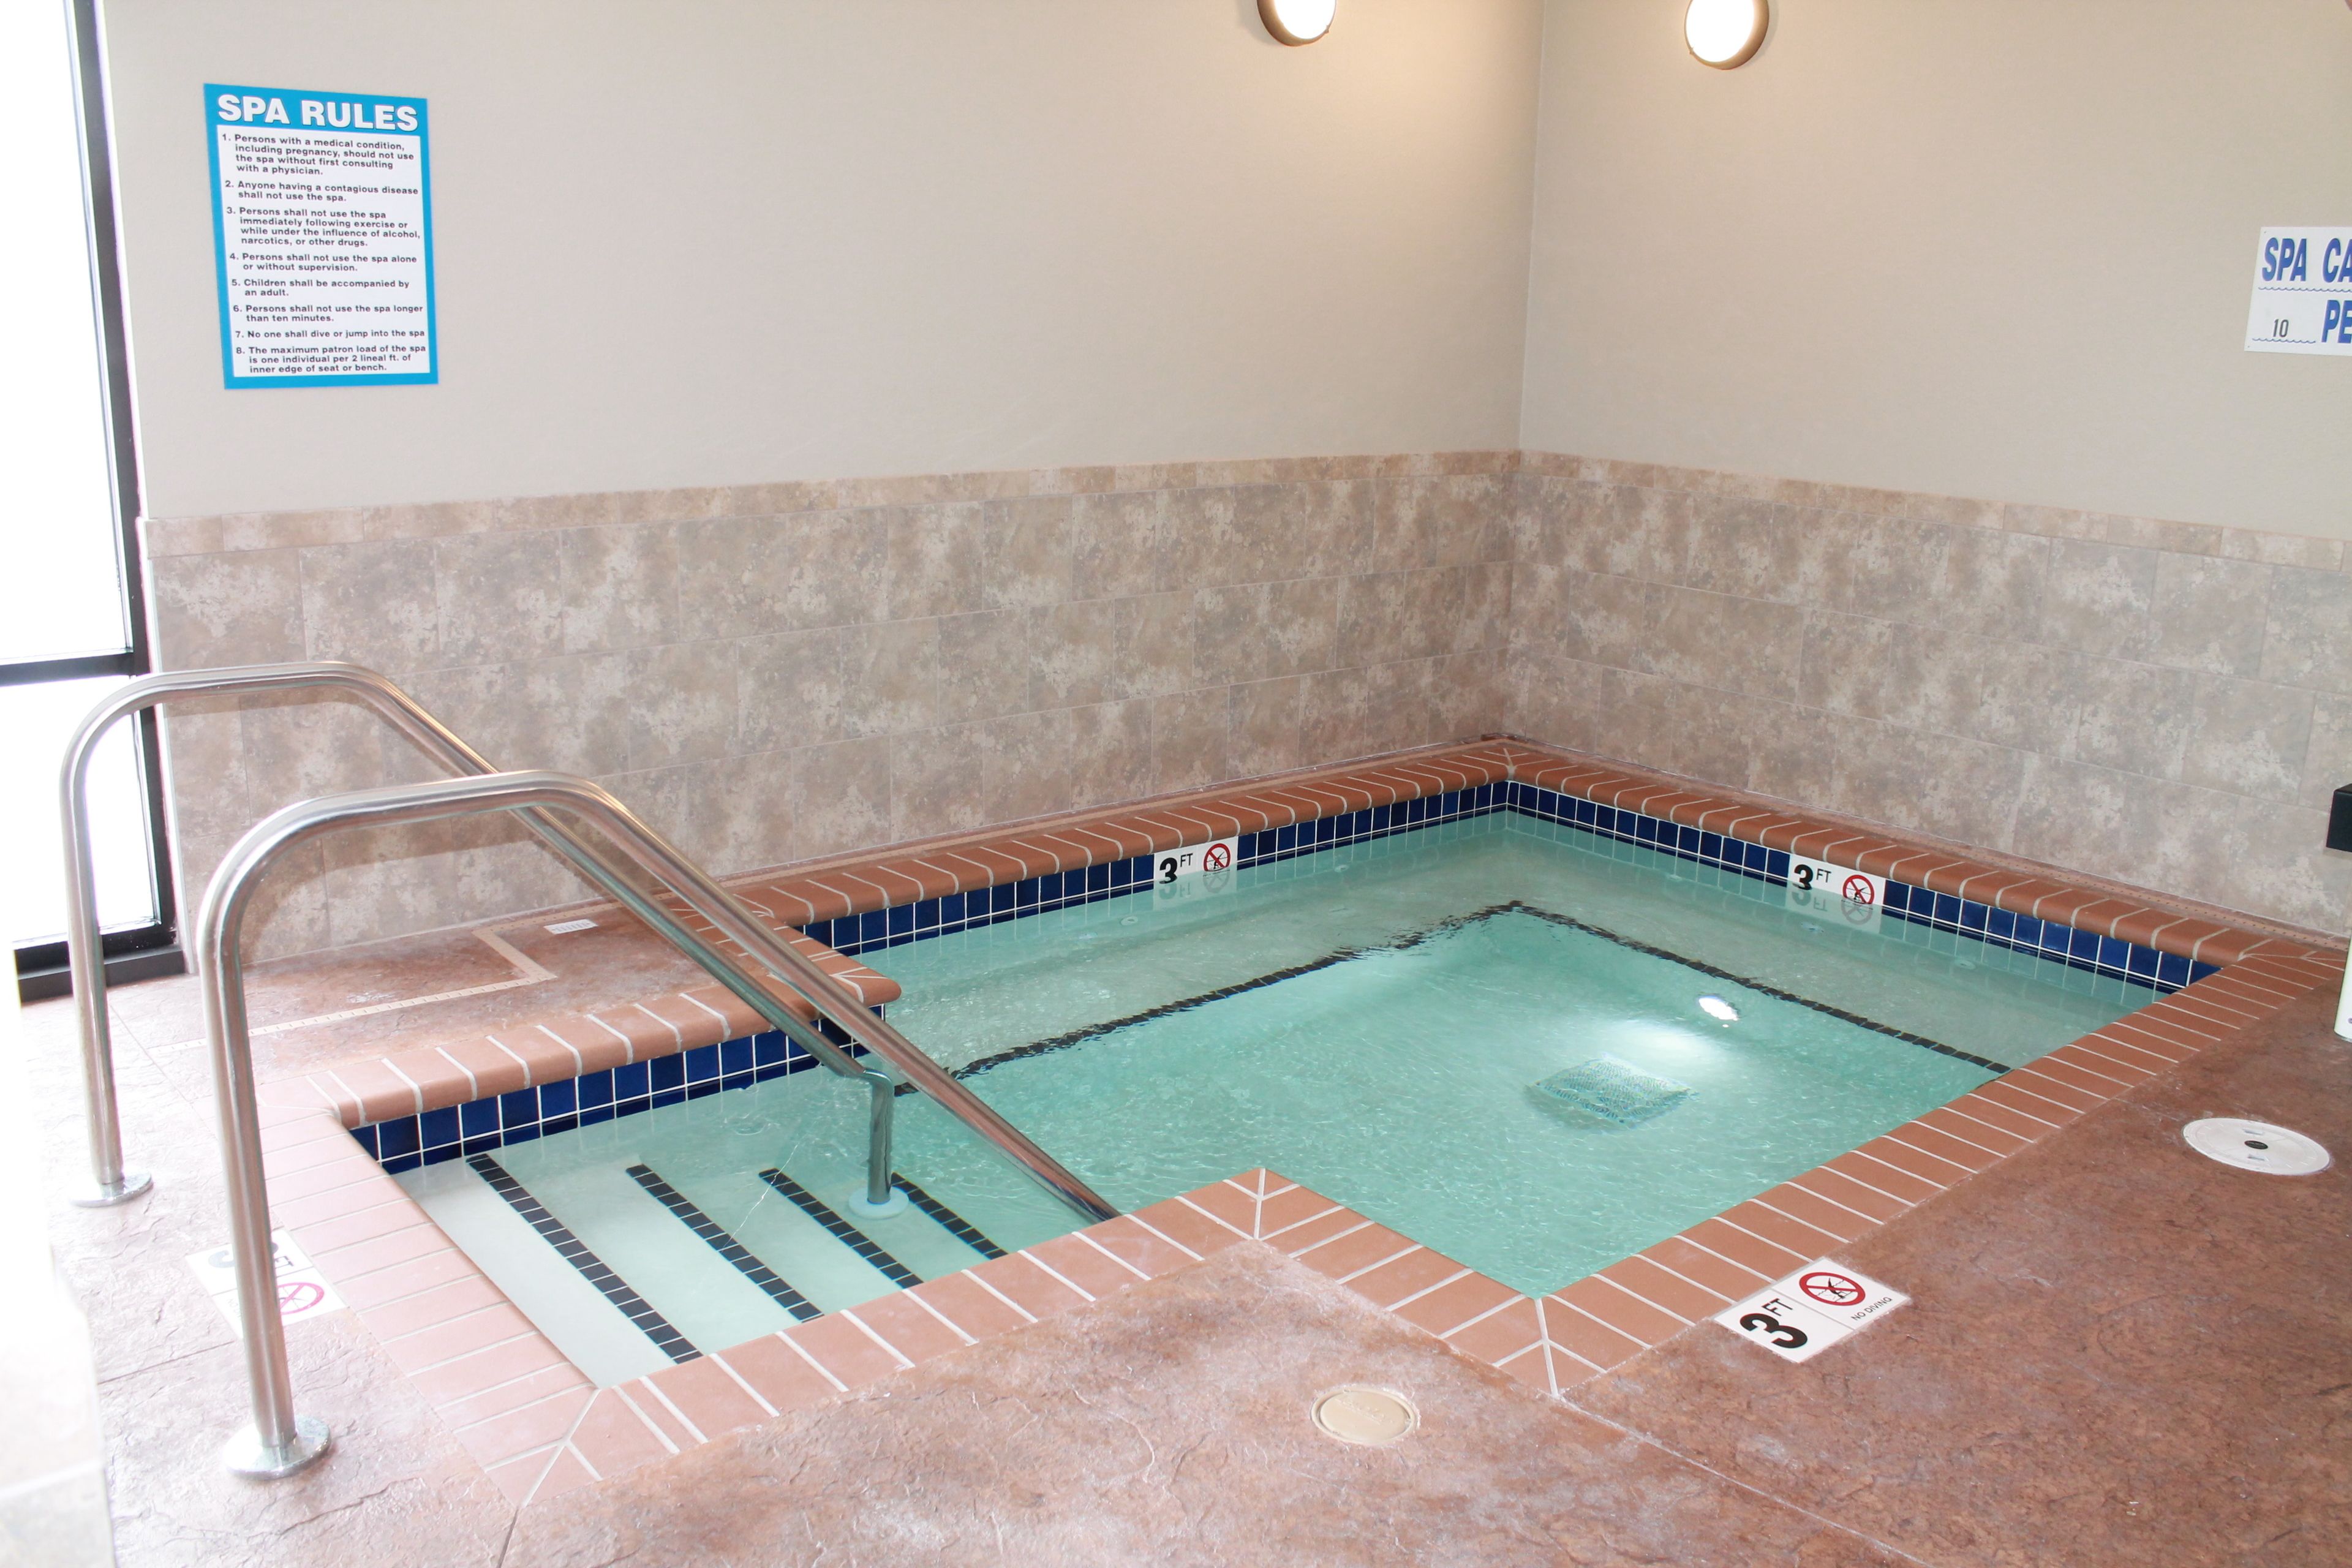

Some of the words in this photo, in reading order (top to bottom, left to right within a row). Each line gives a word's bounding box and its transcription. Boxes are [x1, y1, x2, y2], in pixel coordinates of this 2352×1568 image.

[217, 94, 290, 124] SPA
[301, 99, 418, 132] RULES
[235, 134, 276, 143] Persons
[279, 137, 301, 145] with
[314, 139, 353, 148] medical
[356, 141, 404, 151] condition,
[235, 143, 282, 156] including
[285, 148, 340, 158] pregnancy,
[344, 149, 375, 158] should
[236, 154, 252, 162] the
[277, 156, 315, 165] without
[319, 157, 339, 166] first
[342, 160, 393, 170] consulting
[271, 165, 323, 175] physician.
[238, 180, 276, 190] Anyone
[279, 182, 312, 192] having
[325, 185, 379, 194] contagious
[382, 186, 418, 195] disease
[239, 206, 281, 216] Persons
[240, 217, 303, 227] immediately
[306, 218, 351, 228] following
[323, 228, 368, 237] influence
[383, 230, 420, 239] alcohol,
[241, 237, 292, 246] narcotics,
[337, 238, 368, 247] drugs.
[242, 252, 283, 261] Persons
[2261, 237, 2307, 281] SPA
[298, 263, 357, 272] supervision.
[331, 280, 396, 288] accompanied
[398, 280, 409, 288] by
[394, 305, 423, 314] longer
[2272, 318, 2289, 337] 10
[345, 330, 368, 339] jump
[322, 346, 353, 355] patron
[278, 365, 303, 374] edge
[1159, 858, 1178, 884] 3
[1180, 853, 1193, 867] FT
[1792, 864, 1813, 890] 3
[1816, 869, 1831, 883] FT
[1761, 1298, 1793, 1317] FT
[1851, 1311, 1866, 1321] NO
[1864, 1297, 1893, 1313] DIVING
[1740, 1313, 1808, 1349] 3
